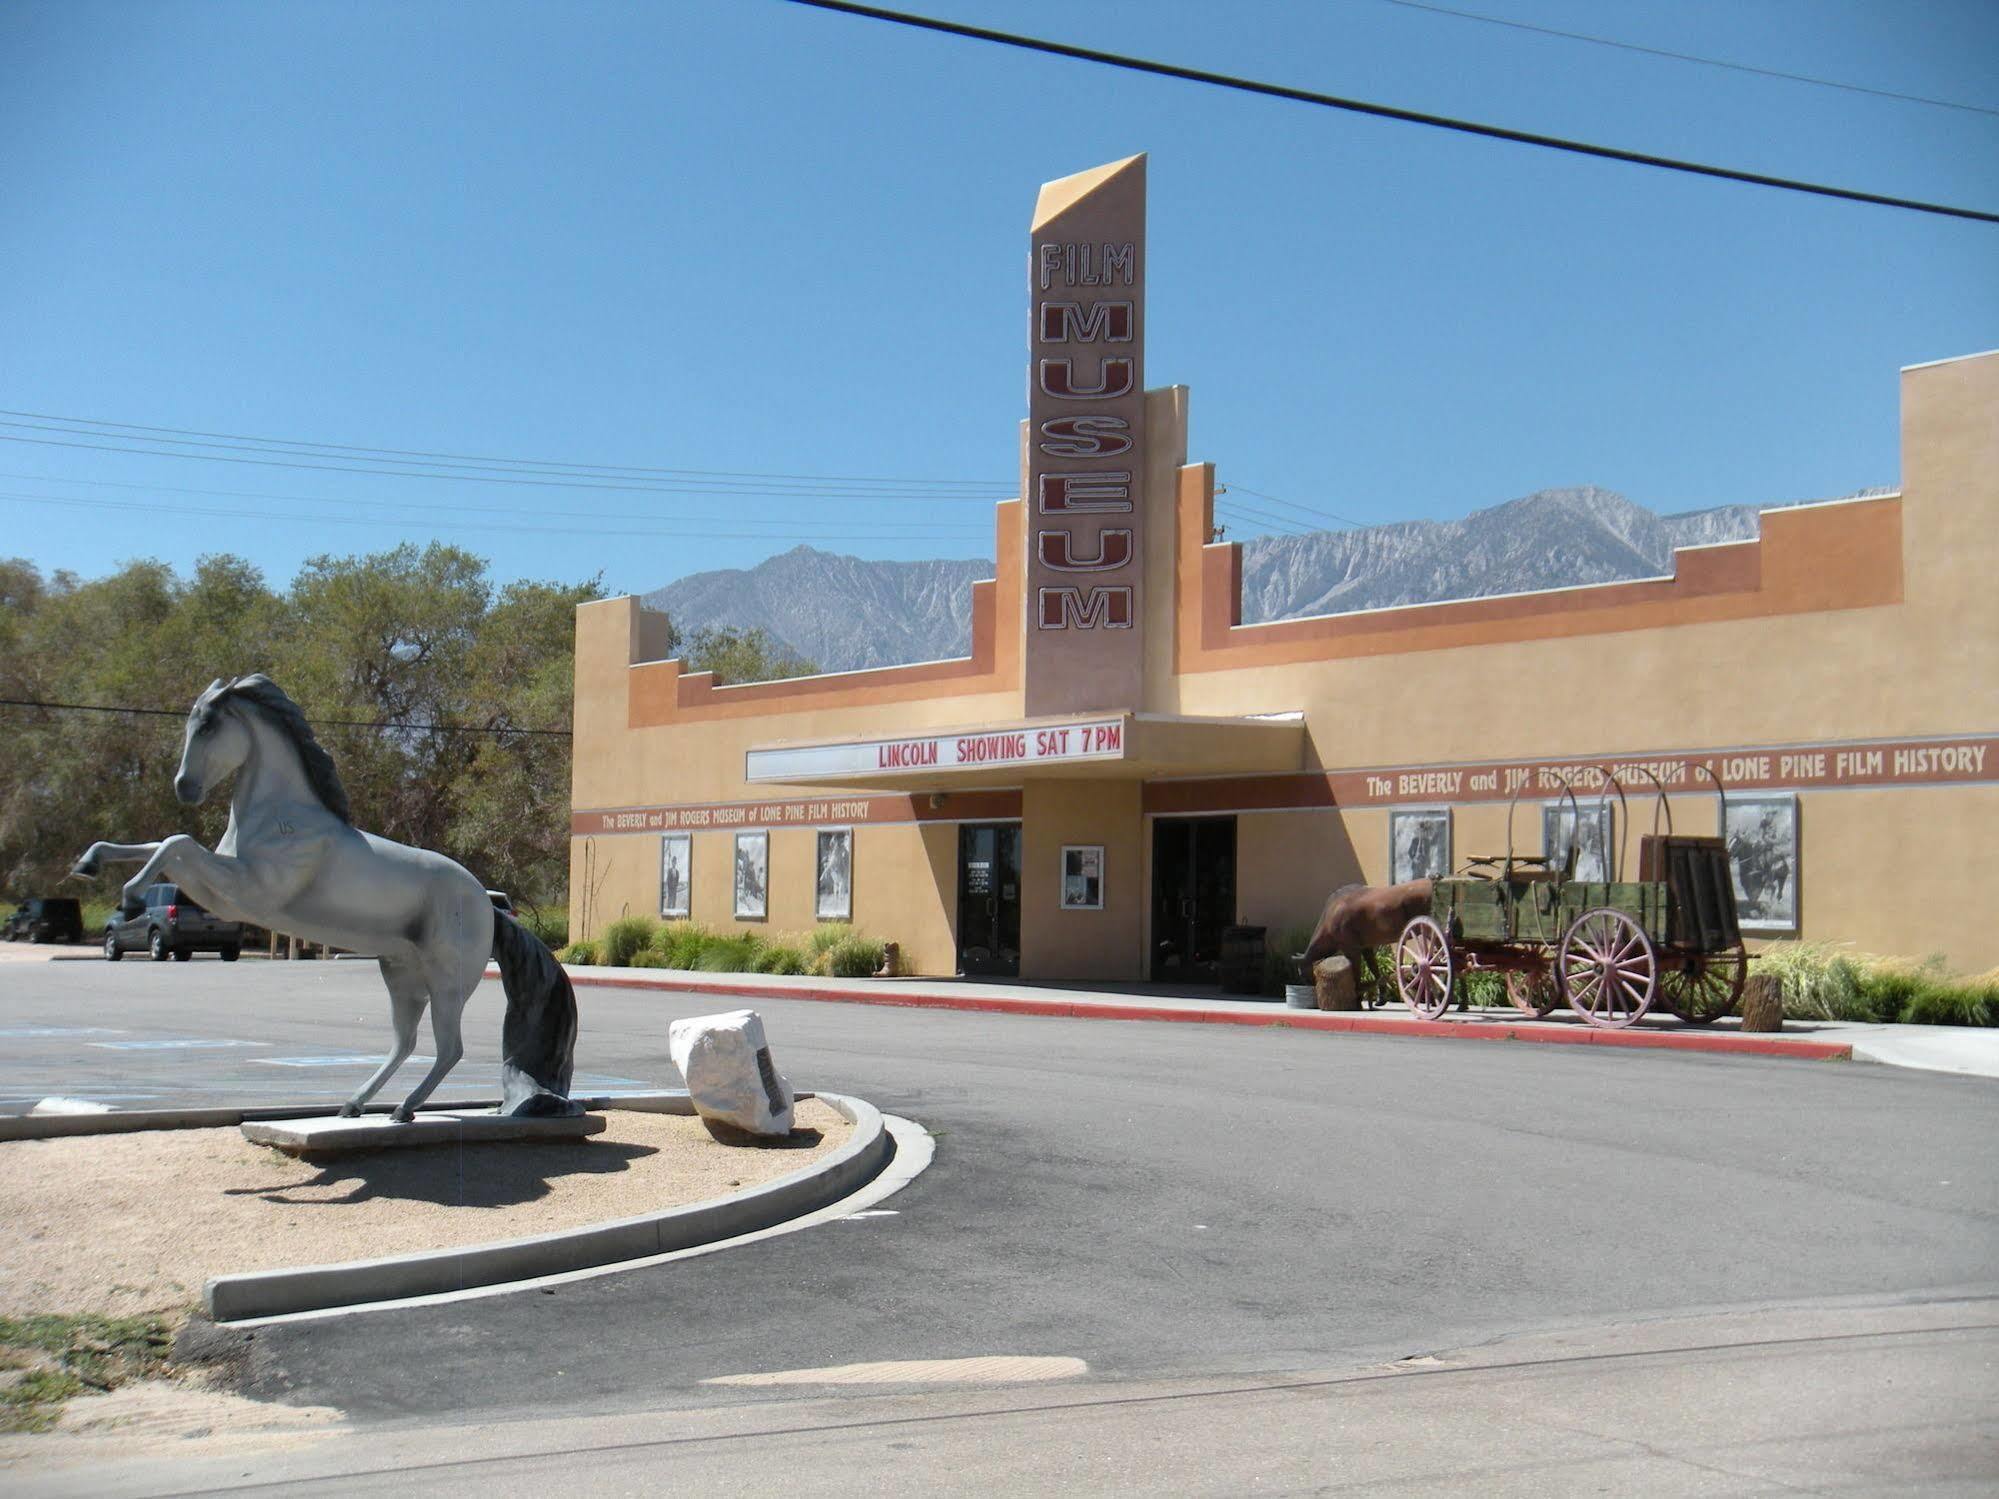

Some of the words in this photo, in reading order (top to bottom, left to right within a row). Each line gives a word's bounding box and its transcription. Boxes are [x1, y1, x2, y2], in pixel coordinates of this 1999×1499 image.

[1040, 243, 1134, 290] FILM
[1038, 302, 1134, 630] MUSEUM
[879, 741, 938, 768] LINCOLN
[957, 734, 1026, 763] SHOWING
[1037, 729, 1070, 756] SAT
[1366, 776, 1392, 796] The
[1398, 771, 1463, 795] BEVERLY
[1469, 769, 1498, 791] and
[1504, 767, 1530, 794] JIM
[1538, 765, 1605, 790] ROGERS
[1612, 760, 1687, 786] MUSEUM
[1694, 759, 1714, 783] of
[1722, 756, 1771, 782] LONE
[1780, 753, 1827, 779] PINE
[1836, 750, 1884, 779] FILM
[1894, 745, 1987, 776] HISTORY
[602, 815, 615, 829] The
[617, 813, 647, 828] BEVERLY
[649, 813, 662, 827] and
[665, 811, 678, 828] JIM
[680, 809, 710, 826] ROGERS
[713, 807, 746, 825] MUSEUM
[748, 807, 758, 822] of
[760, 805, 782, 822] LONE
[785, 804, 804, 820] PINE
[808, 802, 828, 821] FILM
[831, 801, 869, 820] HISTORY
